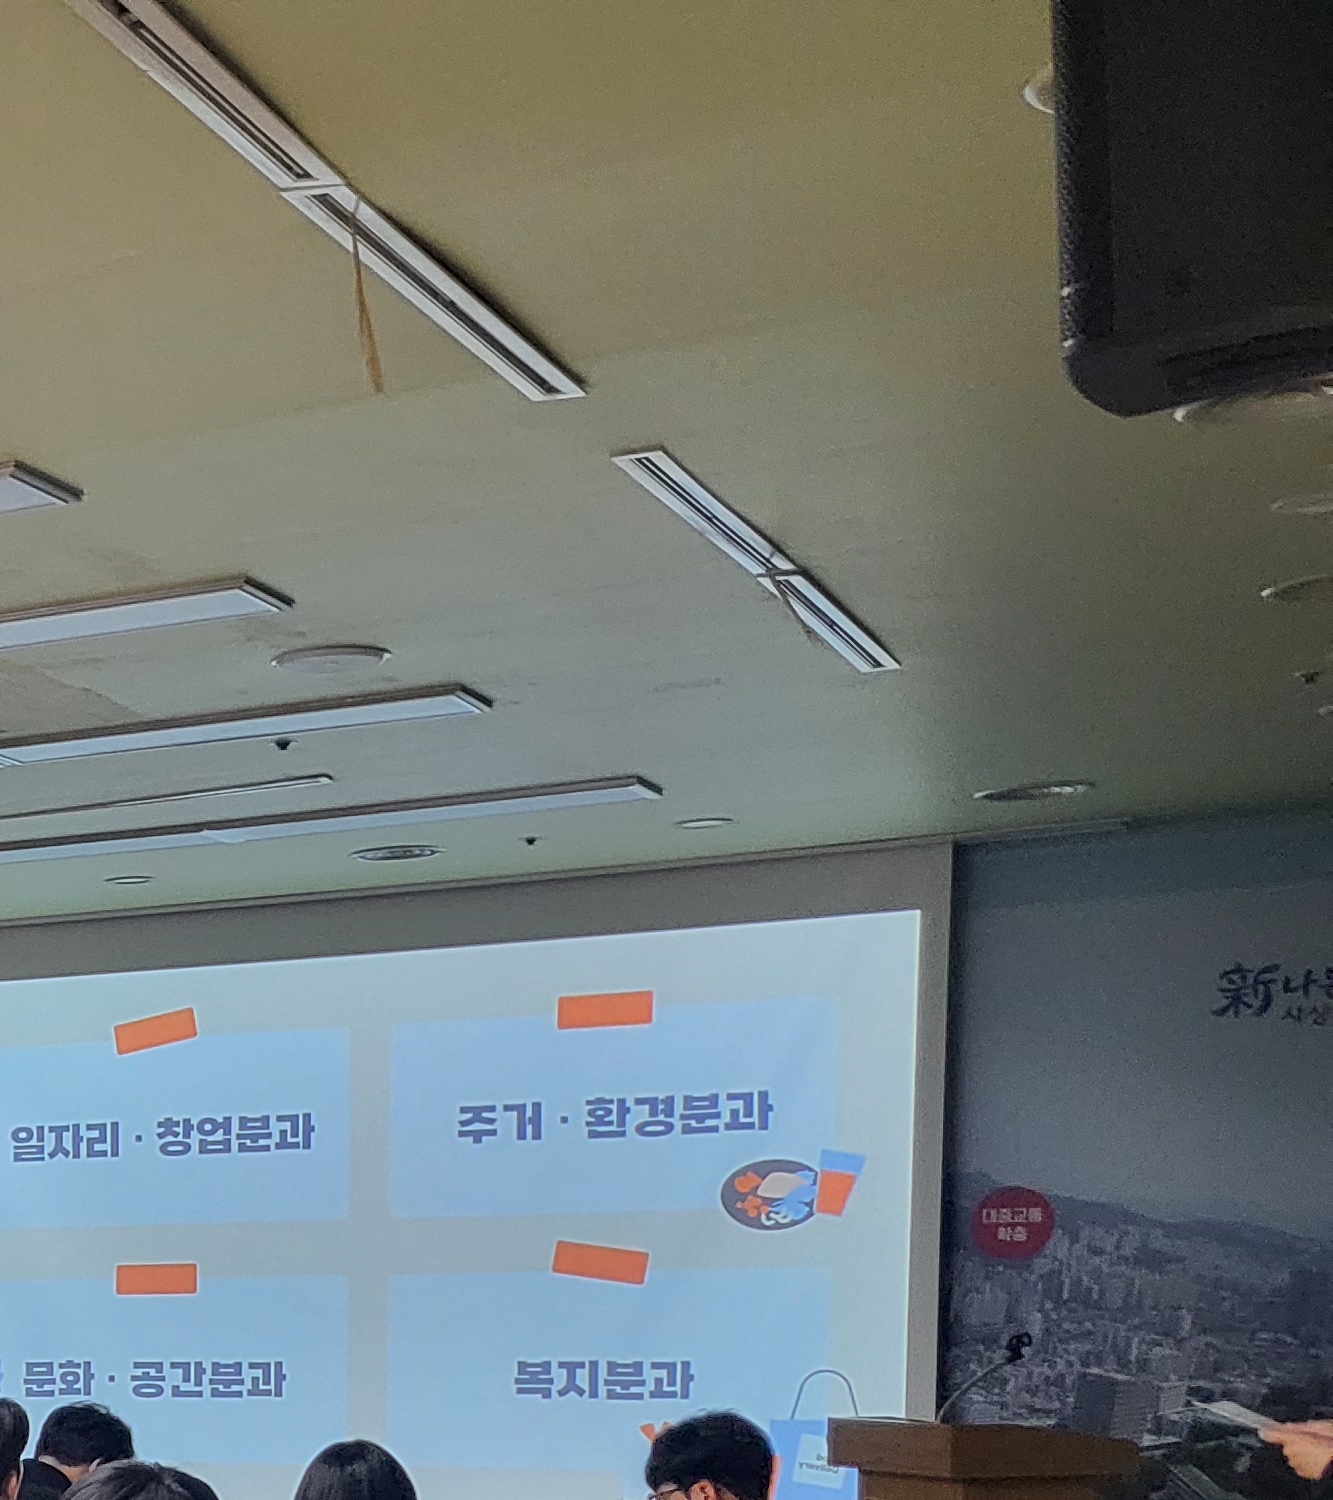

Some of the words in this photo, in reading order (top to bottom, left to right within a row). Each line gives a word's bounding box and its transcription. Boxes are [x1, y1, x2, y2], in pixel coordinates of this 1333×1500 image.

[11, 1121, 120, 1163] 일자리
[155, 1112, 316, 1157] 창업분과
[457, 1101, 542, 1145] 주거
[585, 1089, 774, 1140] 환경분과
[23, 1358, 95, 1398] 문화
[130, 1360, 287, 1399] 공간분과
[514, 1359, 695, 1401] 복지분과
